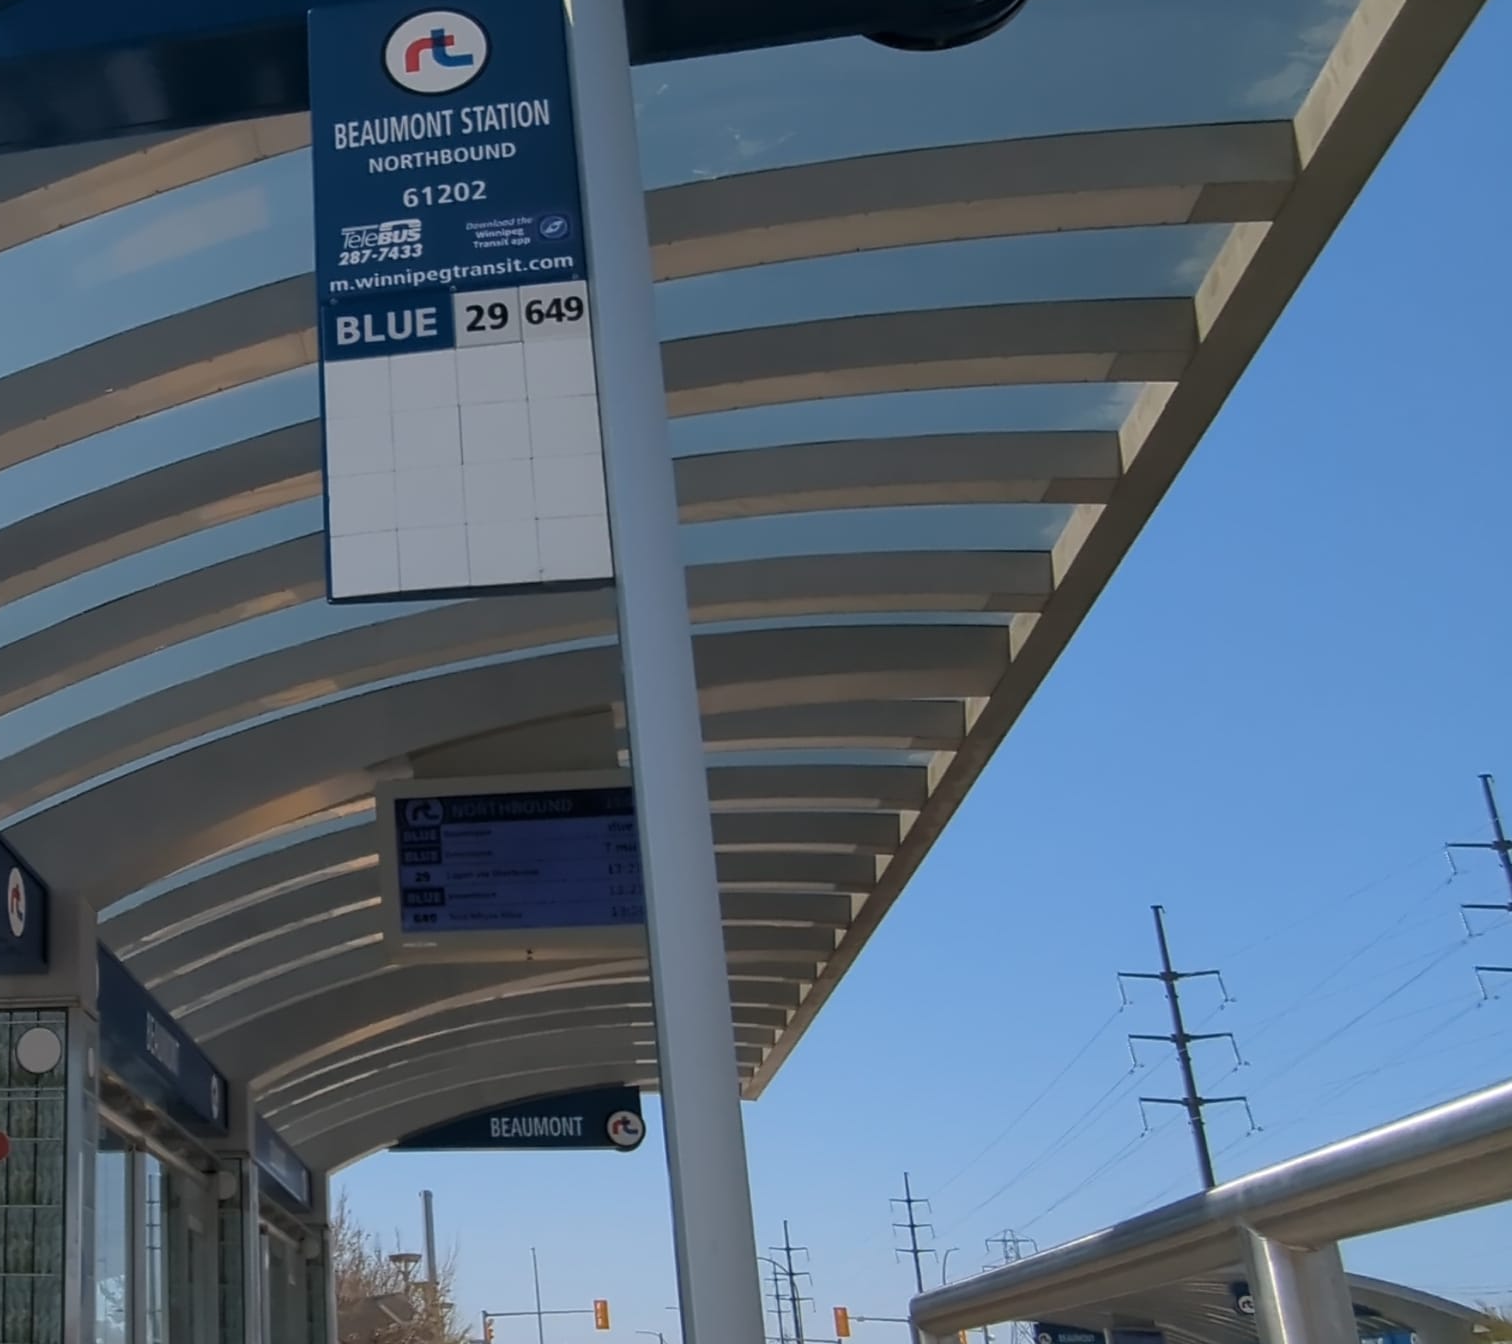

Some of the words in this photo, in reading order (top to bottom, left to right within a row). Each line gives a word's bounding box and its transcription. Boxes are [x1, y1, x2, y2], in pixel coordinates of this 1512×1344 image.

[334, 109, 454, 150] BEAUMONT
[461, 99, 551, 135] STATION
[368, 141, 517, 174] NORTHBOUND
[402, 180, 488, 208] 61202
[465, 218, 516, 231] Download
[516, 216, 534, 225] the
[474, 228, 525, 239] Winnipeg
[337, 242, 424, 266] 287-7433
[472, 237, 510, 249] Transit
[510, 236, 532, 247] app
[329, 254, 575, 294] m.winnipegtransit.com
[336, 307, 438, 346] BLUE
[465, 302, 509, 333] 29
[525, 295, 584, 326] 649
[490, 1116, 584, 1138] BEAUMONT
